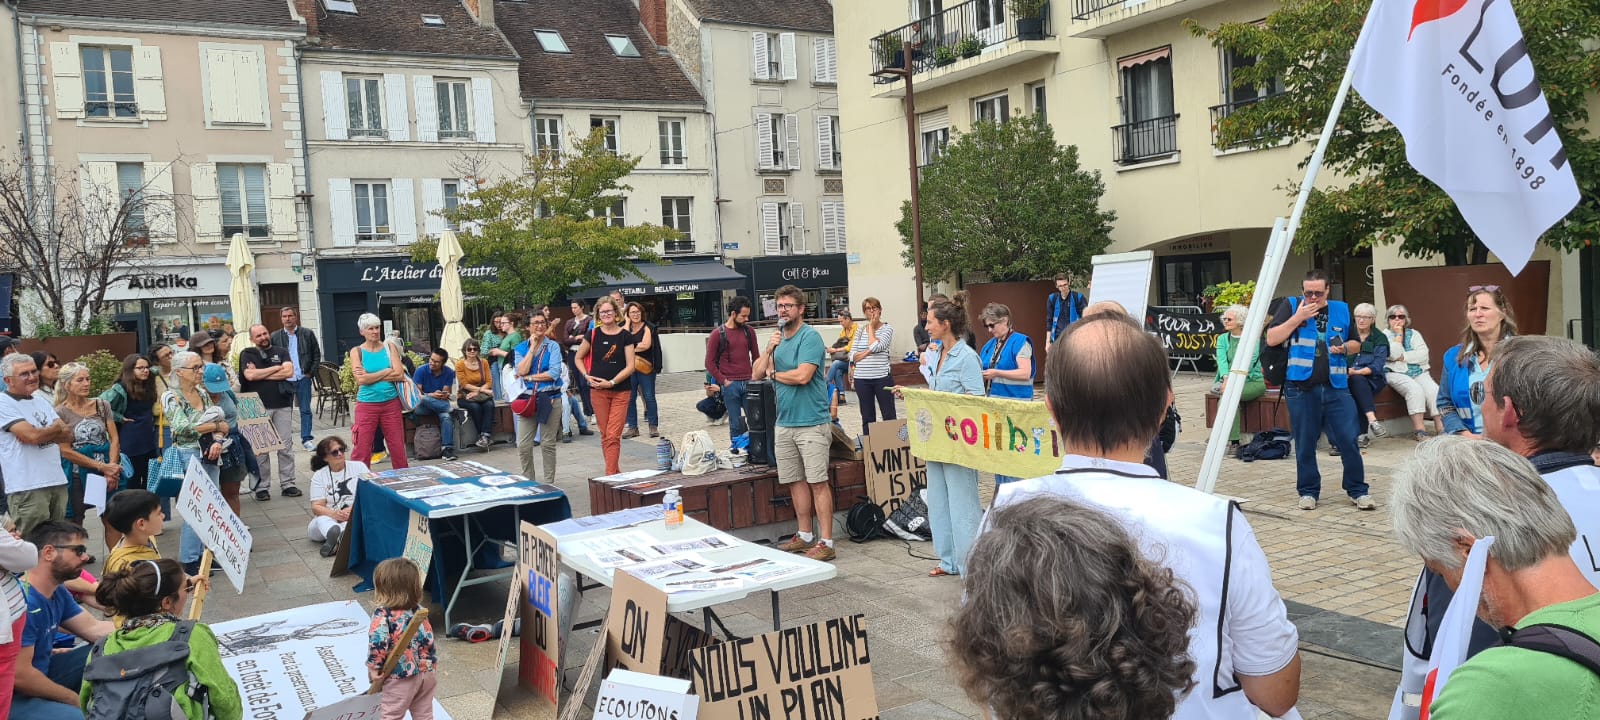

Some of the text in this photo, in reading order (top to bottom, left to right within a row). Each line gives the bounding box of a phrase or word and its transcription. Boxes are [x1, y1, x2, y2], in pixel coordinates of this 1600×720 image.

[1441, 63, 1546, 190] Fondée en 1898
[128, 274, 198, 289] Audika
[361, 264, 427, 282] L'Atelier
[801, 267, 809, 278] &
[153, 301, 177, 309] Experts
[189, 480, 203, 503] NE
[889, 474, 906, 497] IS
[187, 498, 242, 575] PAS AILLEURS
[535, 610, 547, 650] OU
[621, 598, 649, 664] ON
[315, 645, 357, 695] Association Pour
[688, 637, 758, 702] NOUS
[761, 613, 871, 684] VOULONS
[236, 659, 257, 672] en
[247, 692, 278, 705] de
[780, 675, 846, 720] PLAN
[598, 696, 679, 720] ECOUTONS
